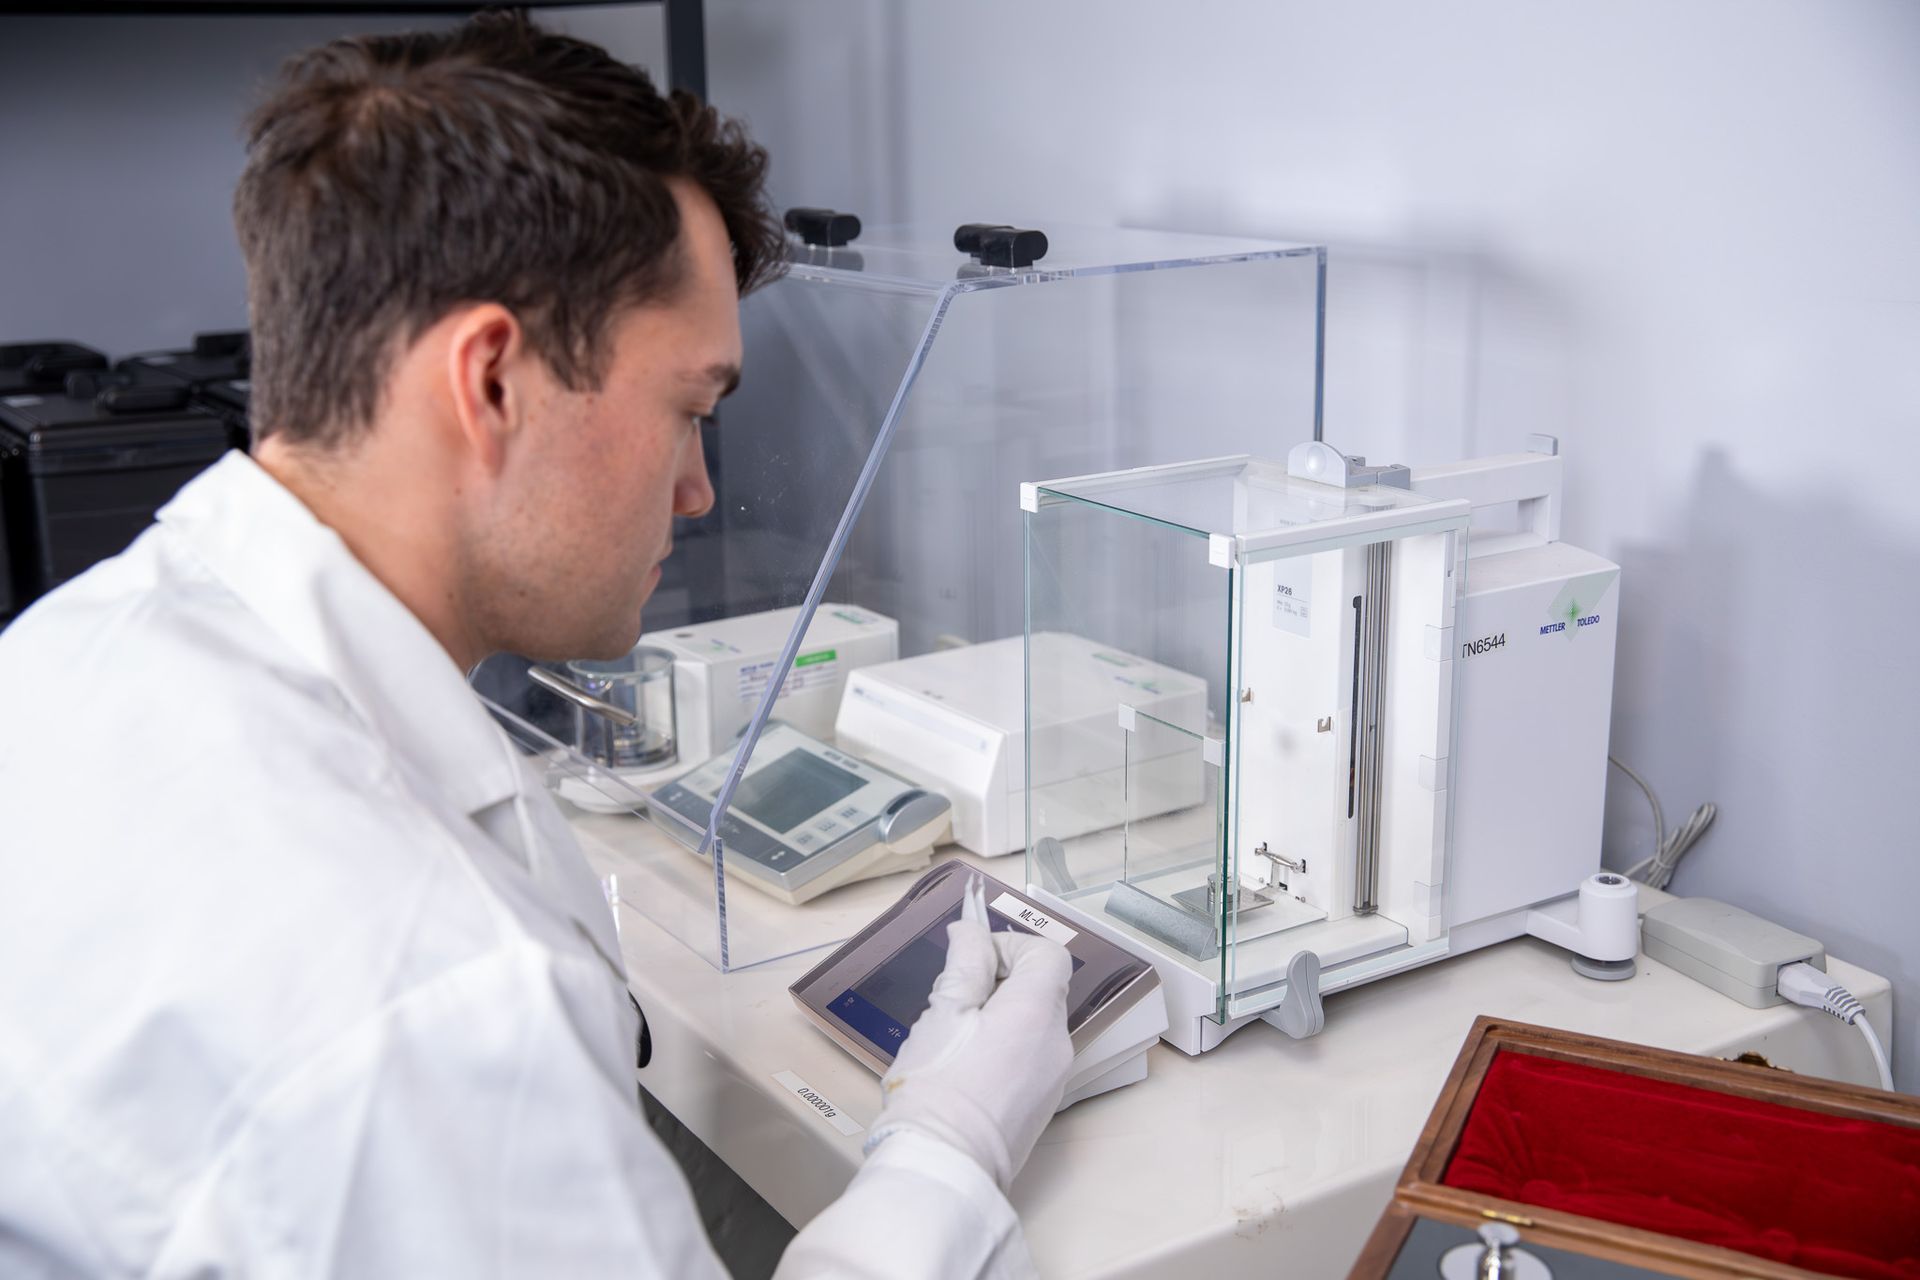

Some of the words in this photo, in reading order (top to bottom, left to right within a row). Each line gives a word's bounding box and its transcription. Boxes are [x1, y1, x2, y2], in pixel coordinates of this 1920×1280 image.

[1540, 622, 1565, 635] METTLER
[1577, 615, 1600, 628] TOLEDO
[1019, 909, 1049, 928] ML-01
[798, 1087, 836, 1118] 0.000001g
